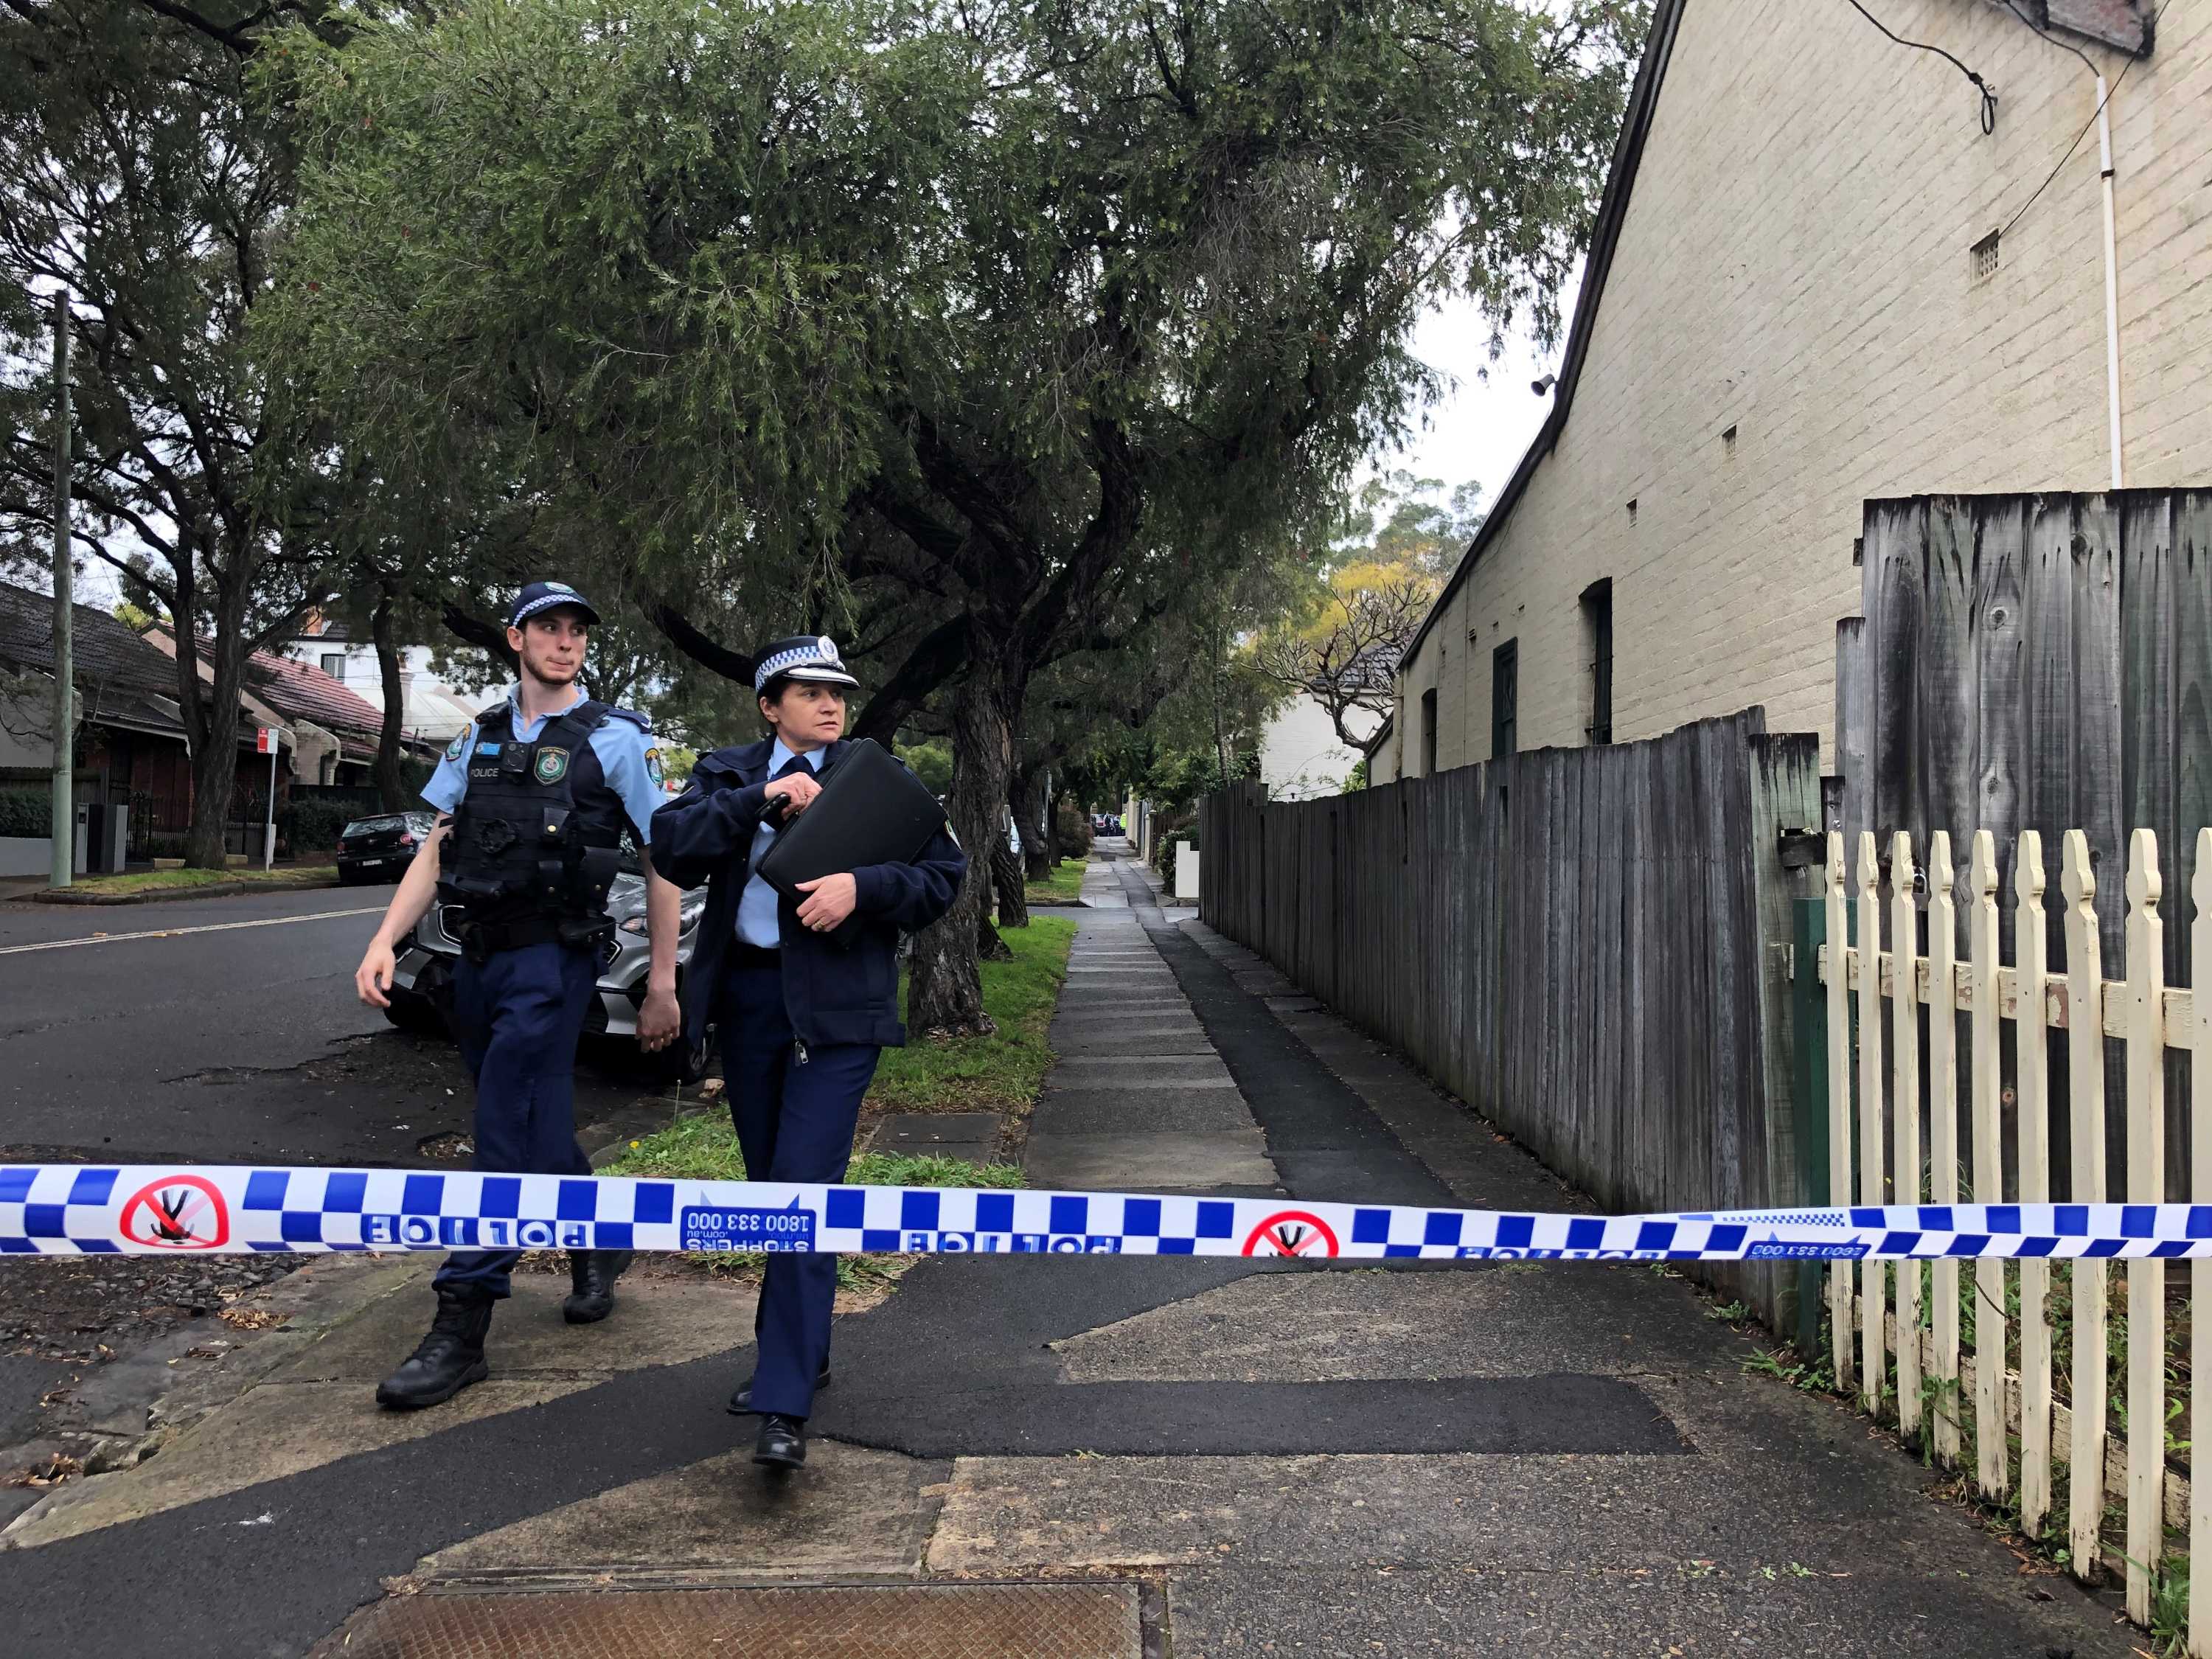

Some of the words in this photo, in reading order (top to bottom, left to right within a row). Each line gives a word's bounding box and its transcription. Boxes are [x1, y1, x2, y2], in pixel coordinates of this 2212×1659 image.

[471, 768, 498, 777] POLICE
[687, 1212, 722, 1229] 000
[728, 1213, 760, 1231] 333
[766, 1214, 810, 1232] 1800
[371, 1215, 587, 1248] POLICE
[686, 1231, 728, 1239] .com.au
